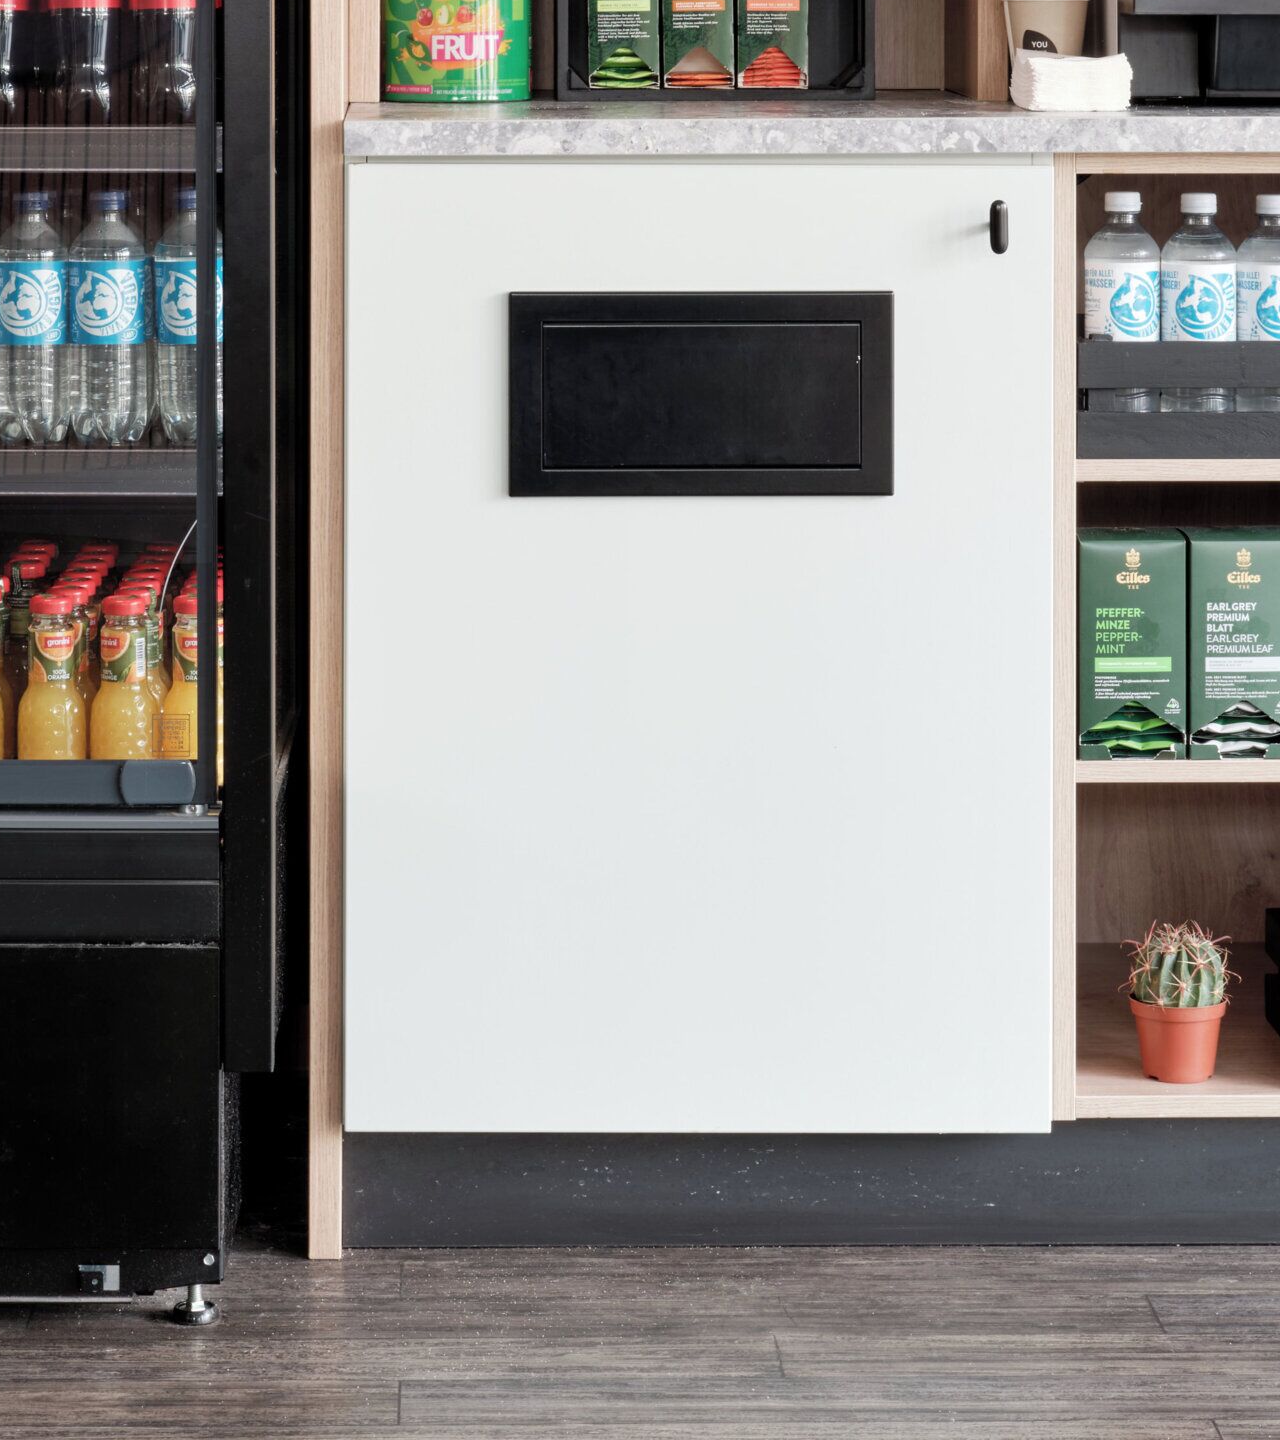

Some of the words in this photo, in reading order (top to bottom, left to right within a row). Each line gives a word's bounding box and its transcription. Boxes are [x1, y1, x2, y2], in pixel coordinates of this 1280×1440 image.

[431, 35, 499, 60] FRUIT
[1098, 270, 1113, 278] ALLE!
[1089, 278, 1115, 289] WASSER!
[1116, 571, 1150, 585] Eilles
[1227, 571, 1261, 585] Eilles
[1206, 602, 1231, 611] EARL
[1231, 602, 1257, 612] GREY
[1096, 608, 1145, 618] PFEFFER-
[1206, 613, 1249, 622] PREMIUM
[1096, 620, 1130, 630] MINZE
[1206, 623, 1233, 632] BLATT
[47, 638, 69, 647] granini
[1095, 632, 1142, 643] PEPPER-
[1206, 634, 1232, 643] EARL
[1232, 634, 1259, 643] GREY
[1095, 644, 1125, 654] MINT
[1206, 644, 1251, 654] PREMIUM
[1251, 644, 1274, 653] LEAF
